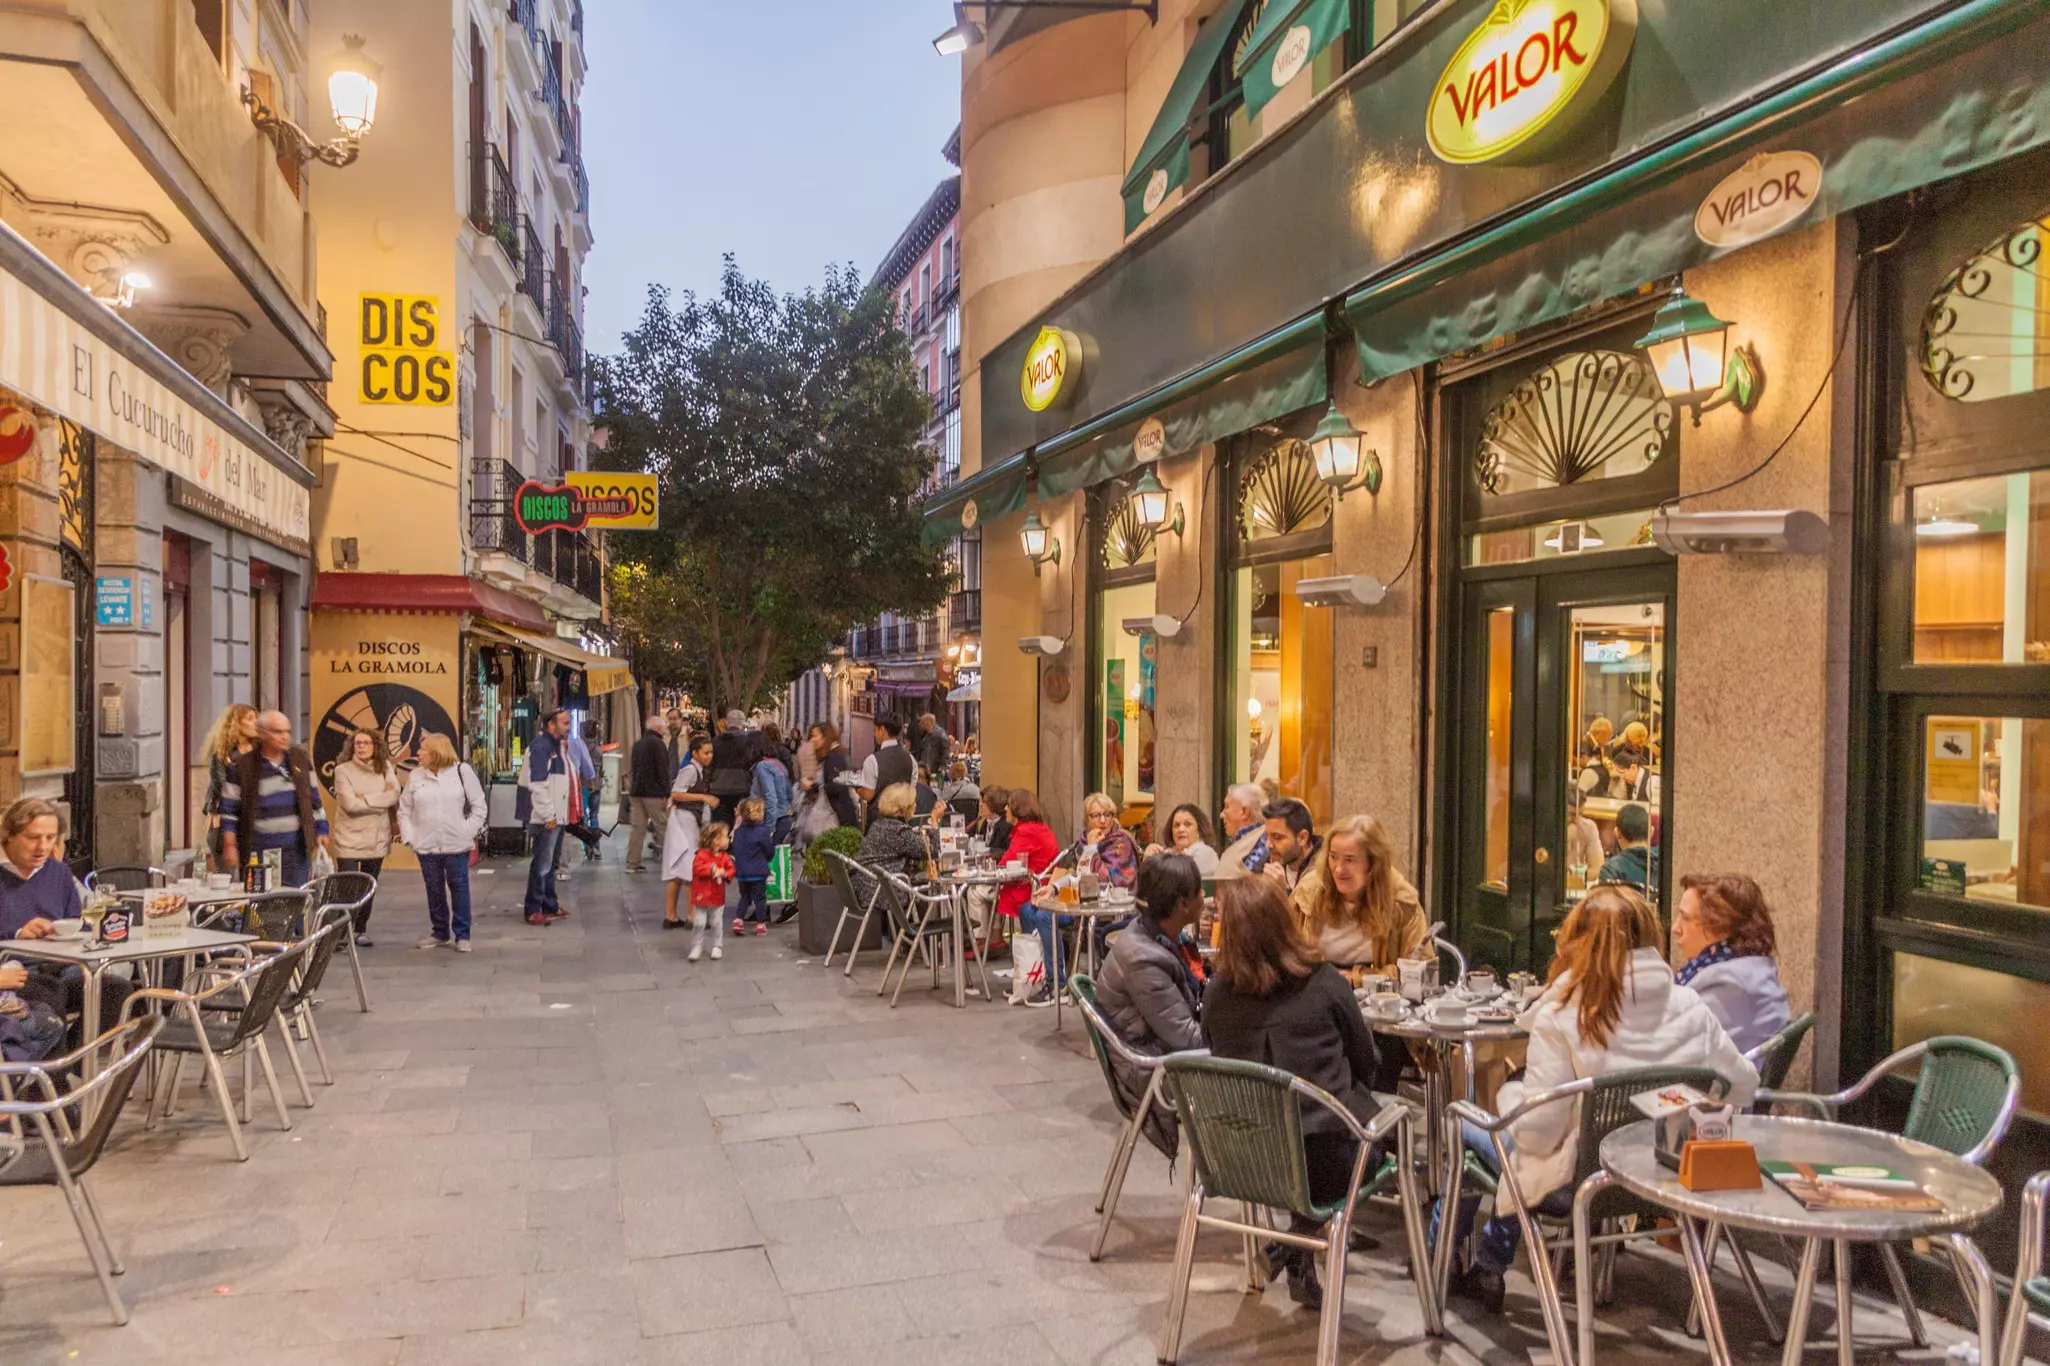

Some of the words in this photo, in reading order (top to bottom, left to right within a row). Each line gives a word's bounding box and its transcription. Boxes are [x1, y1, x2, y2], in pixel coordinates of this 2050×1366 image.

[1276, 37, 1306, 73] VALOR
[1444, 10, 1588, 129] VALOR
[1709, 169, 1808, 227] VALOR
[362, 297, 435, 347] DIS
[362, 353, 451, 403] COS
[1027, 348, 1063, 392] VALOR
[73, 343, 94, 402] El
[108, 370, 194, 460] Cucurucho
[224, 447, 241, 488] del
[247, 462, 267, 502] Mar
[1137, 429, 1162, 449] VALOR
[523, 496, 568, 520] DISCOS
[571, 501, 582, 514] LA
[586, 501, 626, 514] GRAMOLA
[330, 660, 353, 674] LA
[358, 661, 447, 674] GRAMOLA
[358, 641, 421, 655] DISCOS
